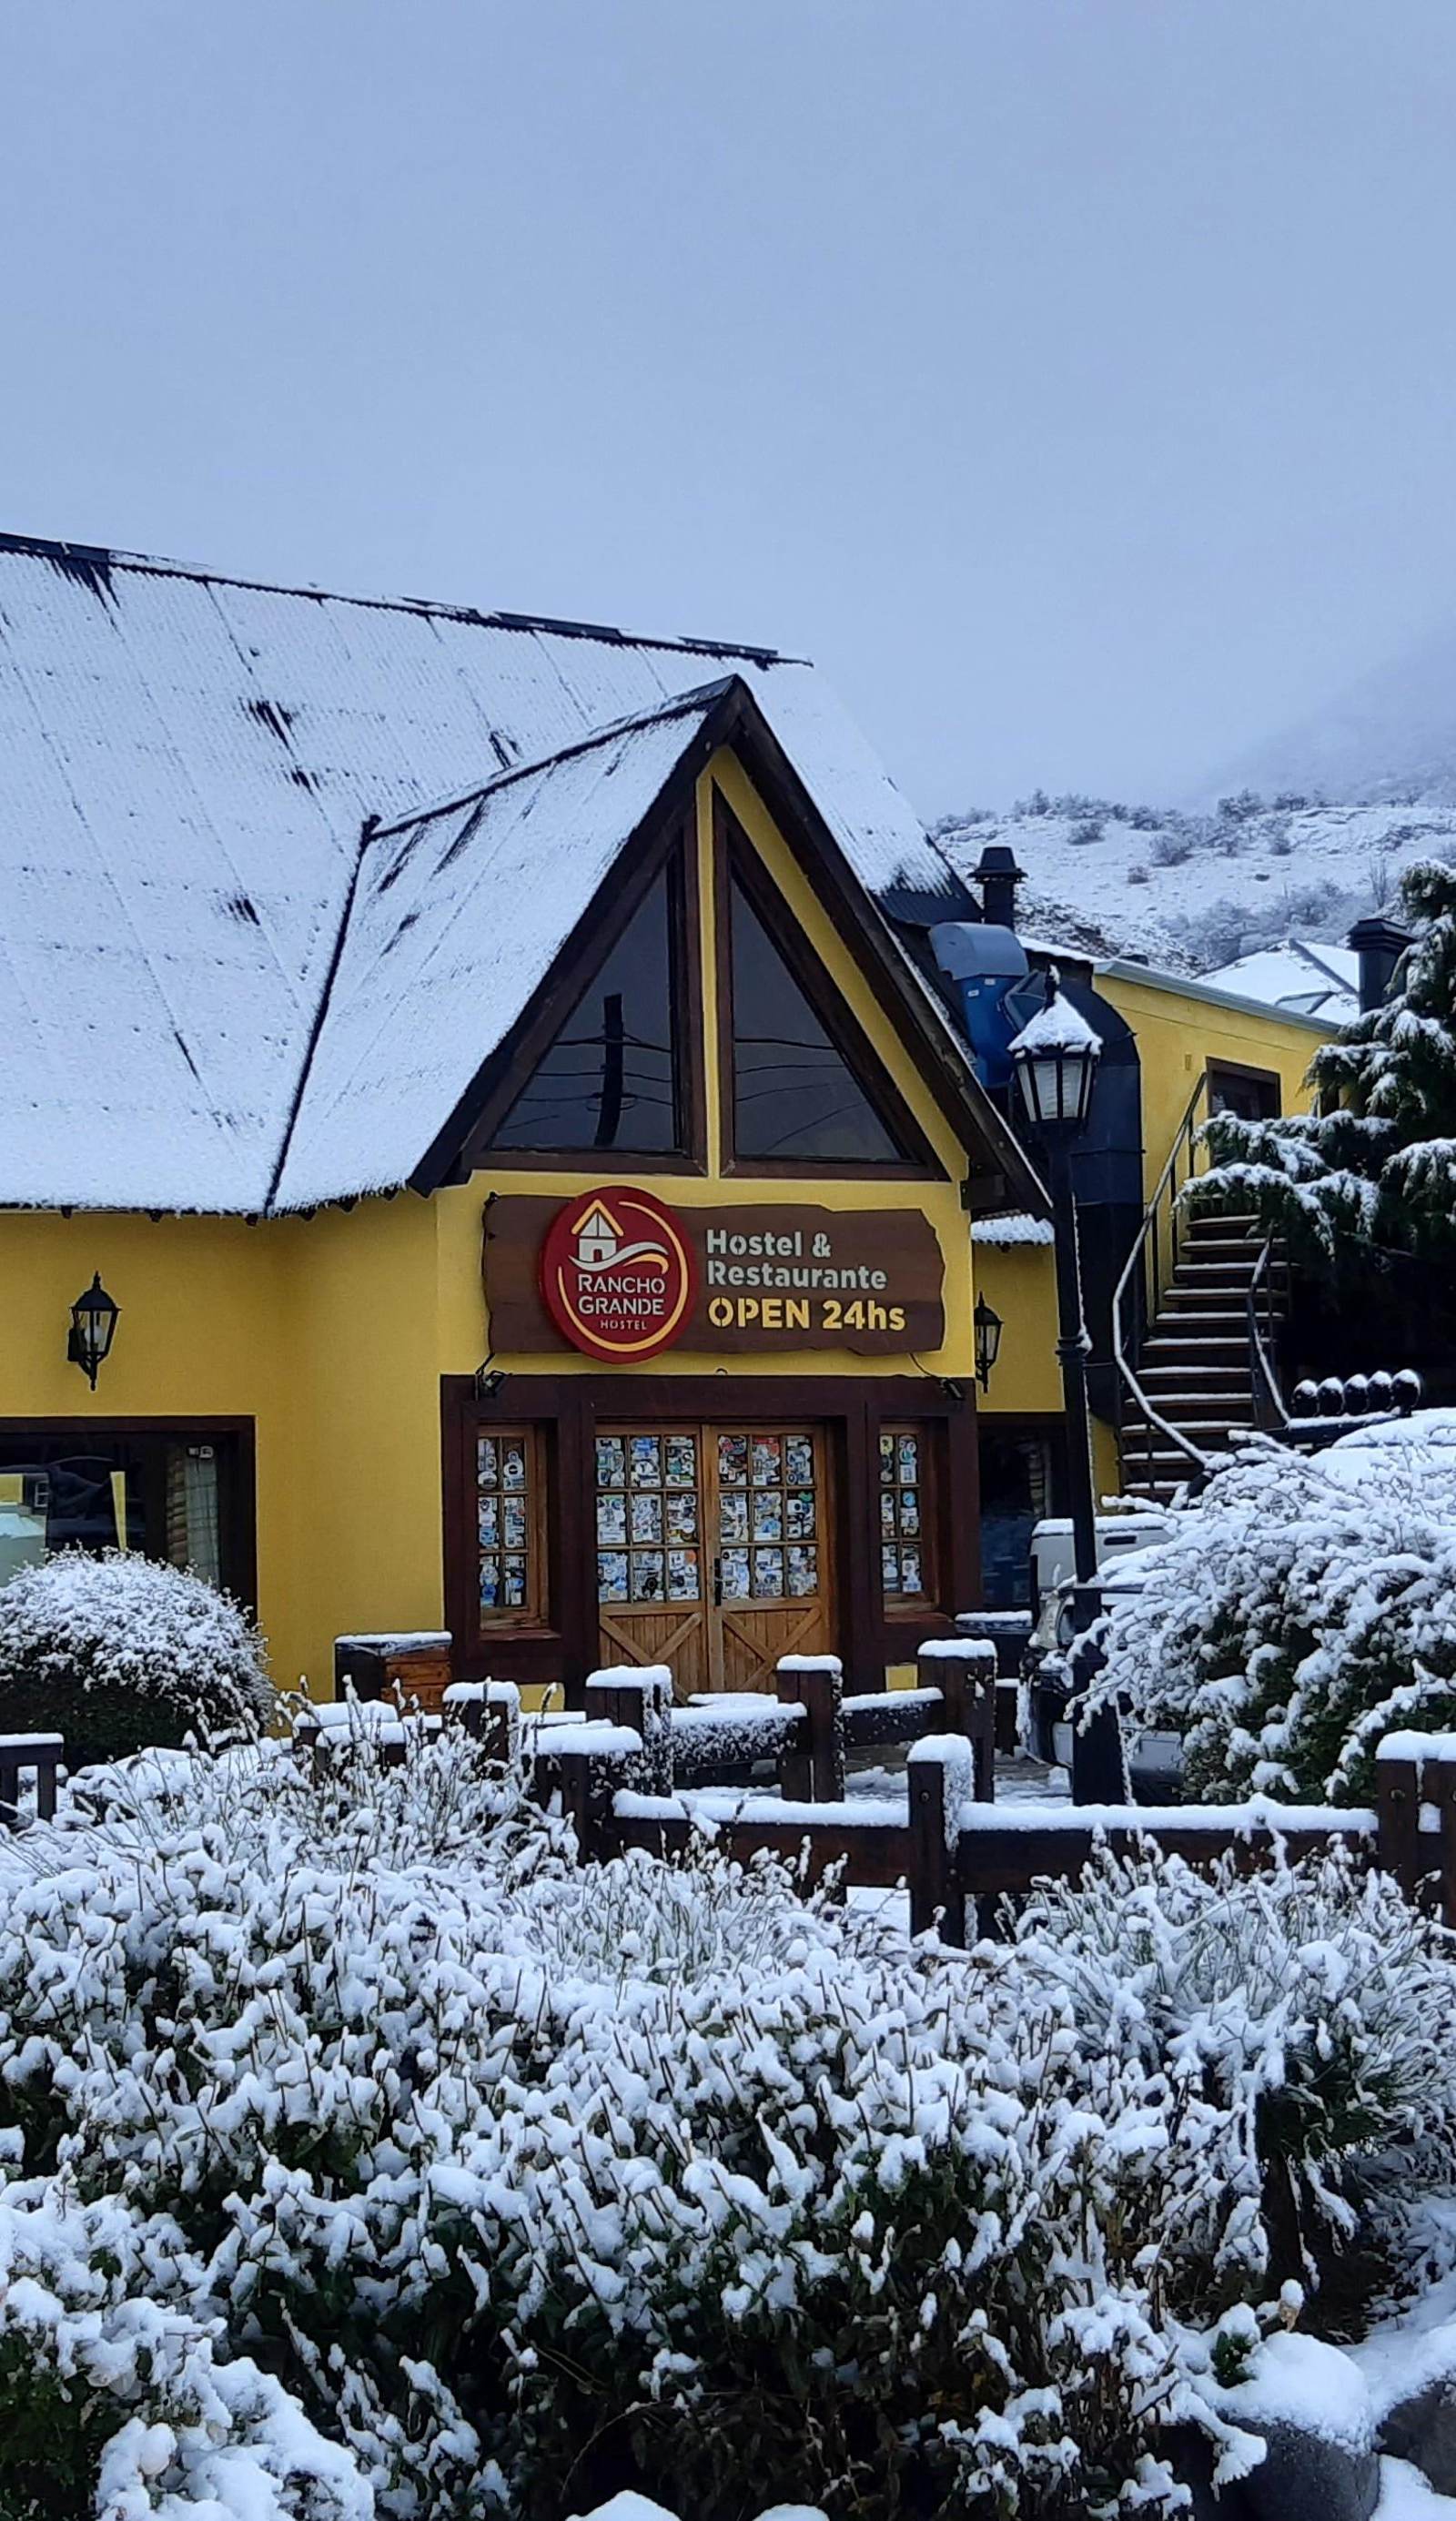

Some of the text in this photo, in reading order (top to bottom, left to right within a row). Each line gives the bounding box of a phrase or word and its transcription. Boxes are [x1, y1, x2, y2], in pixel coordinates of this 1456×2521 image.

[707, 1229, 832, 1258] Hostel &
[578, 1274, 665, 1294] RANCHO
[707, 1260, 887, 1290] Restaurante
[578, 1295, 665, 1315] GRANDE
[708, 1297, 905, 1331] OPEN 24hs
[600, 1320, 648, 1330] HOSTEL
